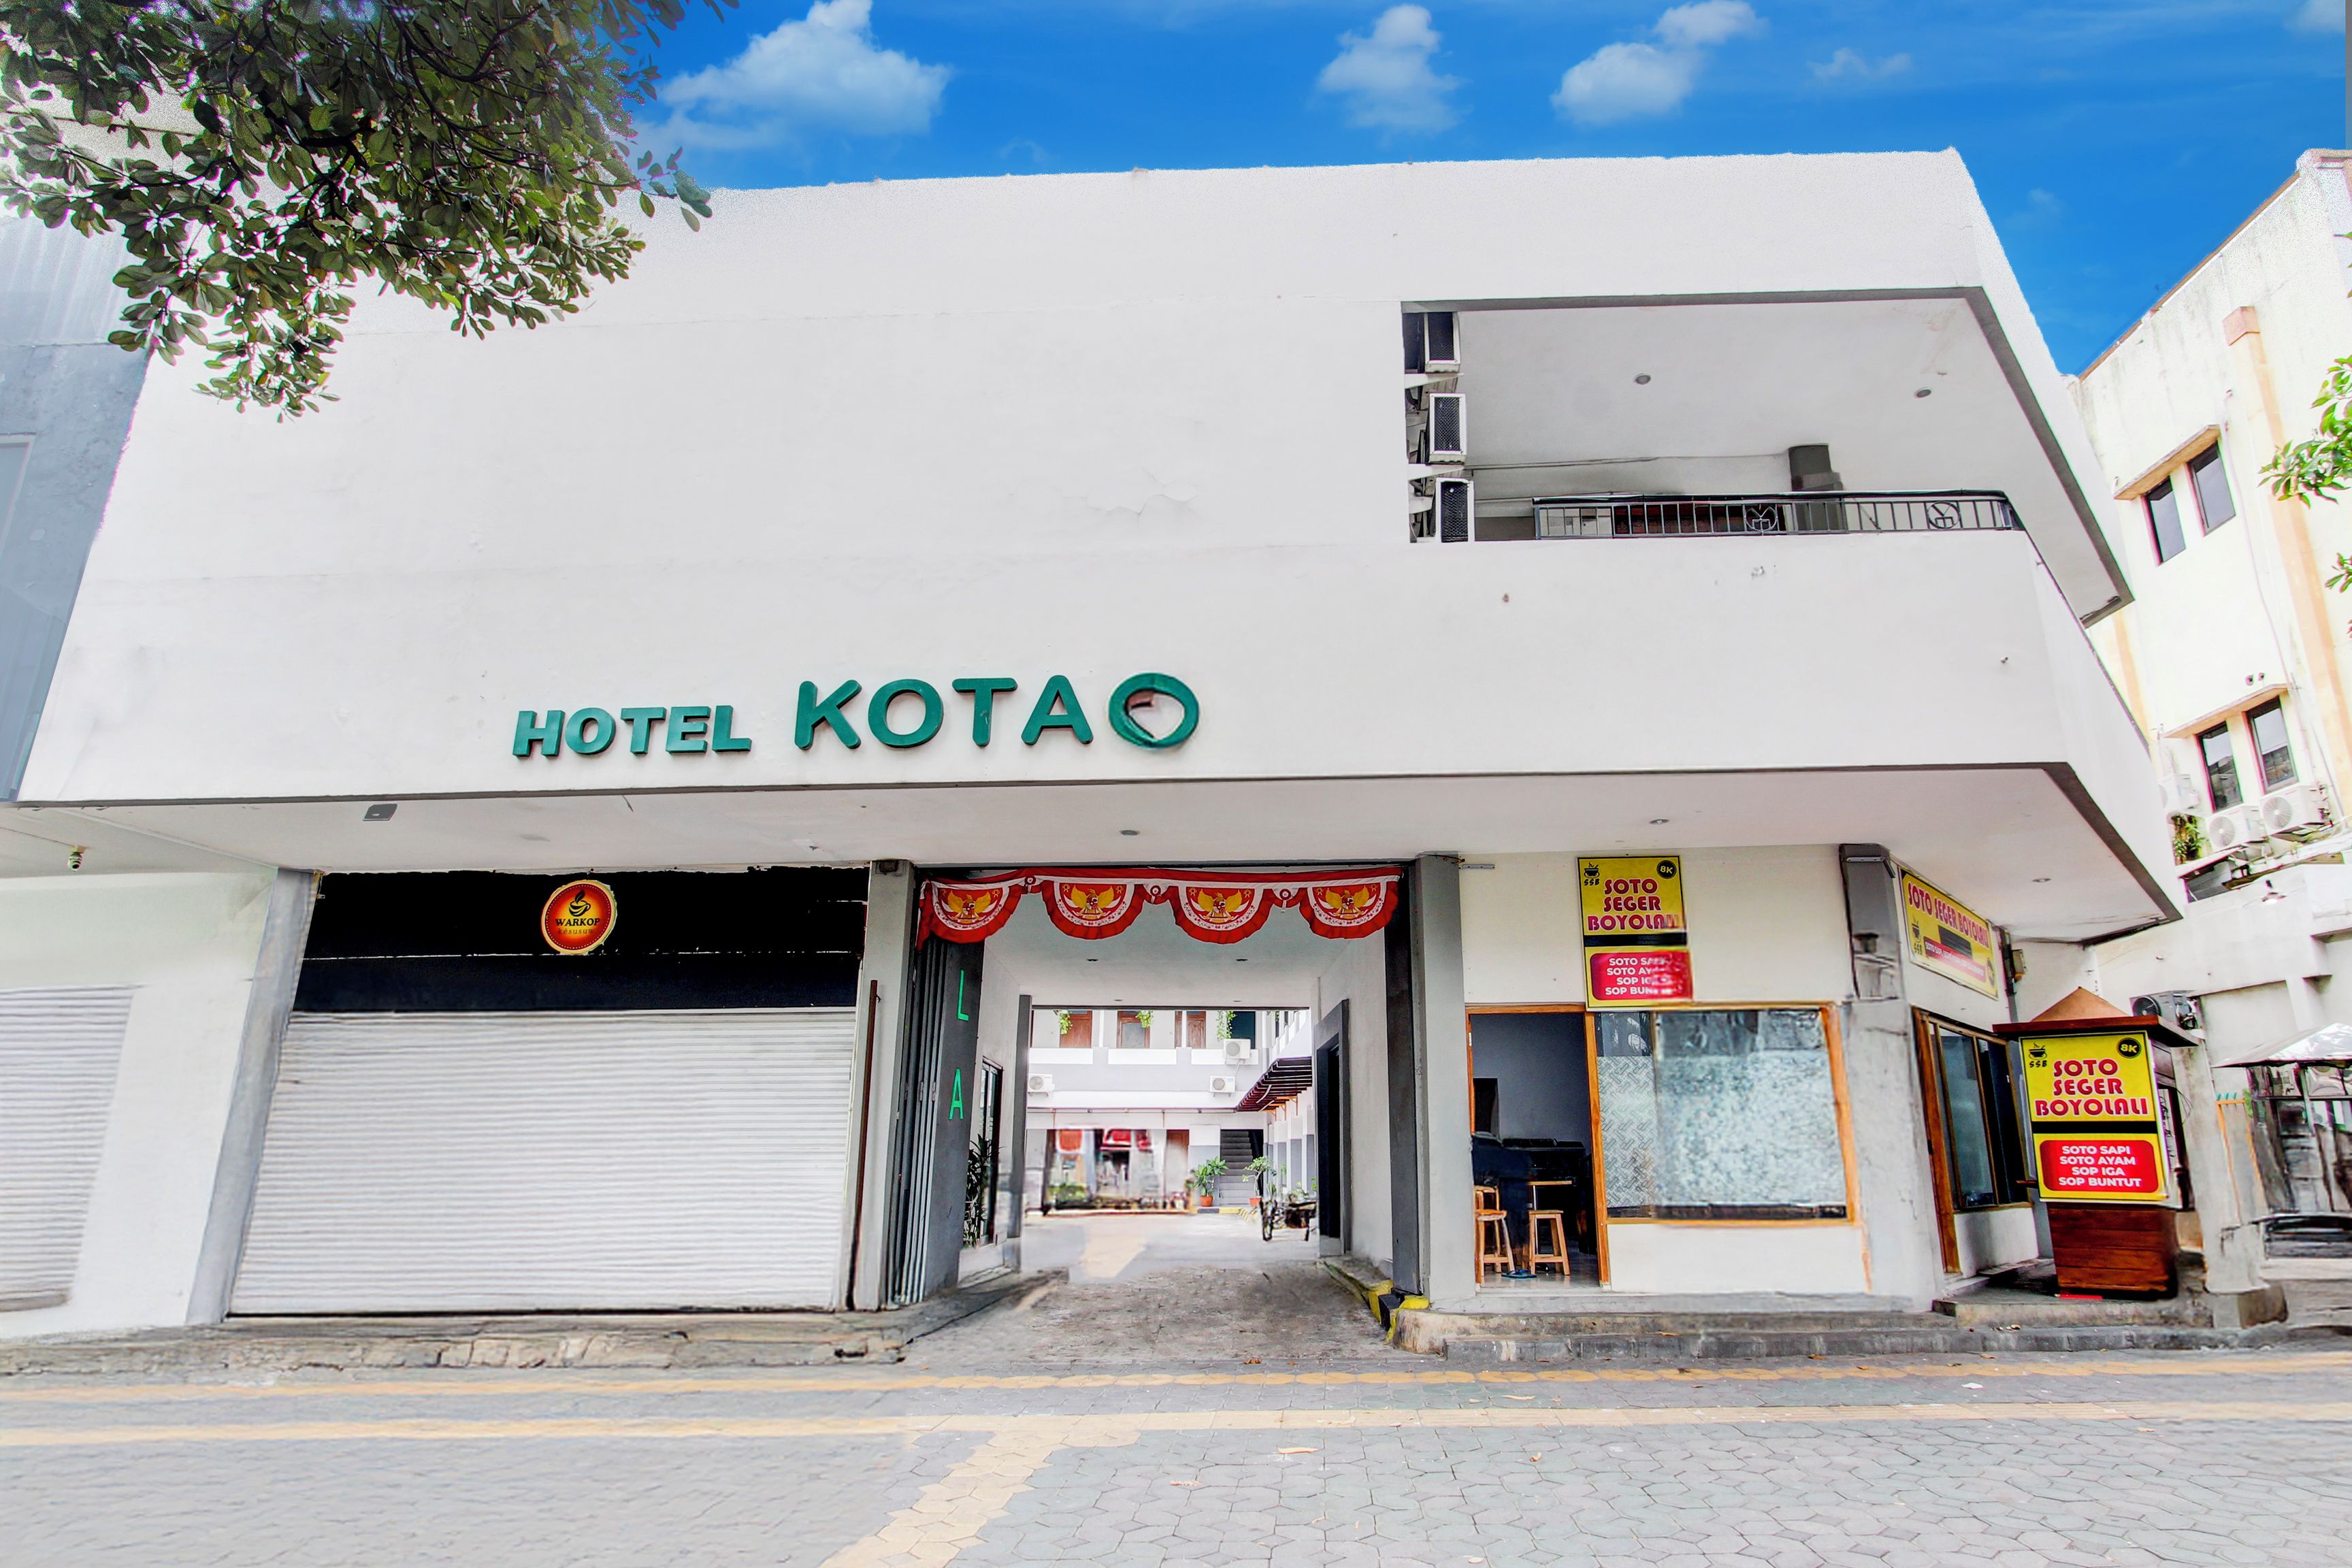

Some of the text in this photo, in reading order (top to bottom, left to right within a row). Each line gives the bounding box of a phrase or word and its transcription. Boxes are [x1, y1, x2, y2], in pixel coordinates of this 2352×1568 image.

[512, 704, 751, 757] HOTEL
[1660, 865, 1673, 874] 8K
[1584, 878, 1600, 886] SSB
[1604, 878, 1658, 895] SOTO
[1603, 896, 1662, 912] SEGER
[1908, 883, 1932, 915] SOTO
[1934, 898, 1958, 930] SEGER
[555, 918, 600, 926] WARKOP
[1609, 957, 1638, 966] SOTO
[1606, 967, 1635, 976] SOTO
[1616, 977, 1638, 985] SOP
[1605, 987, 1627, 996] SOP
[2120, 1043, 2137, 1054] 8K
[2053, 1058, 2119, 1077] SOTO
[2053, 1078, 2124, 1096] SEGER
[2035, 1098, 2149, 1116] BOYOLALI
[2062, 1145, 2130, 1155] SOTO SAPI
[2059, 1156, 2136, 1165] SOTO AYAM
[2072, 1167, 2125, 1176] SOP IGA
[2059, 1177, 2142, 1187] SOP BUNTUT
